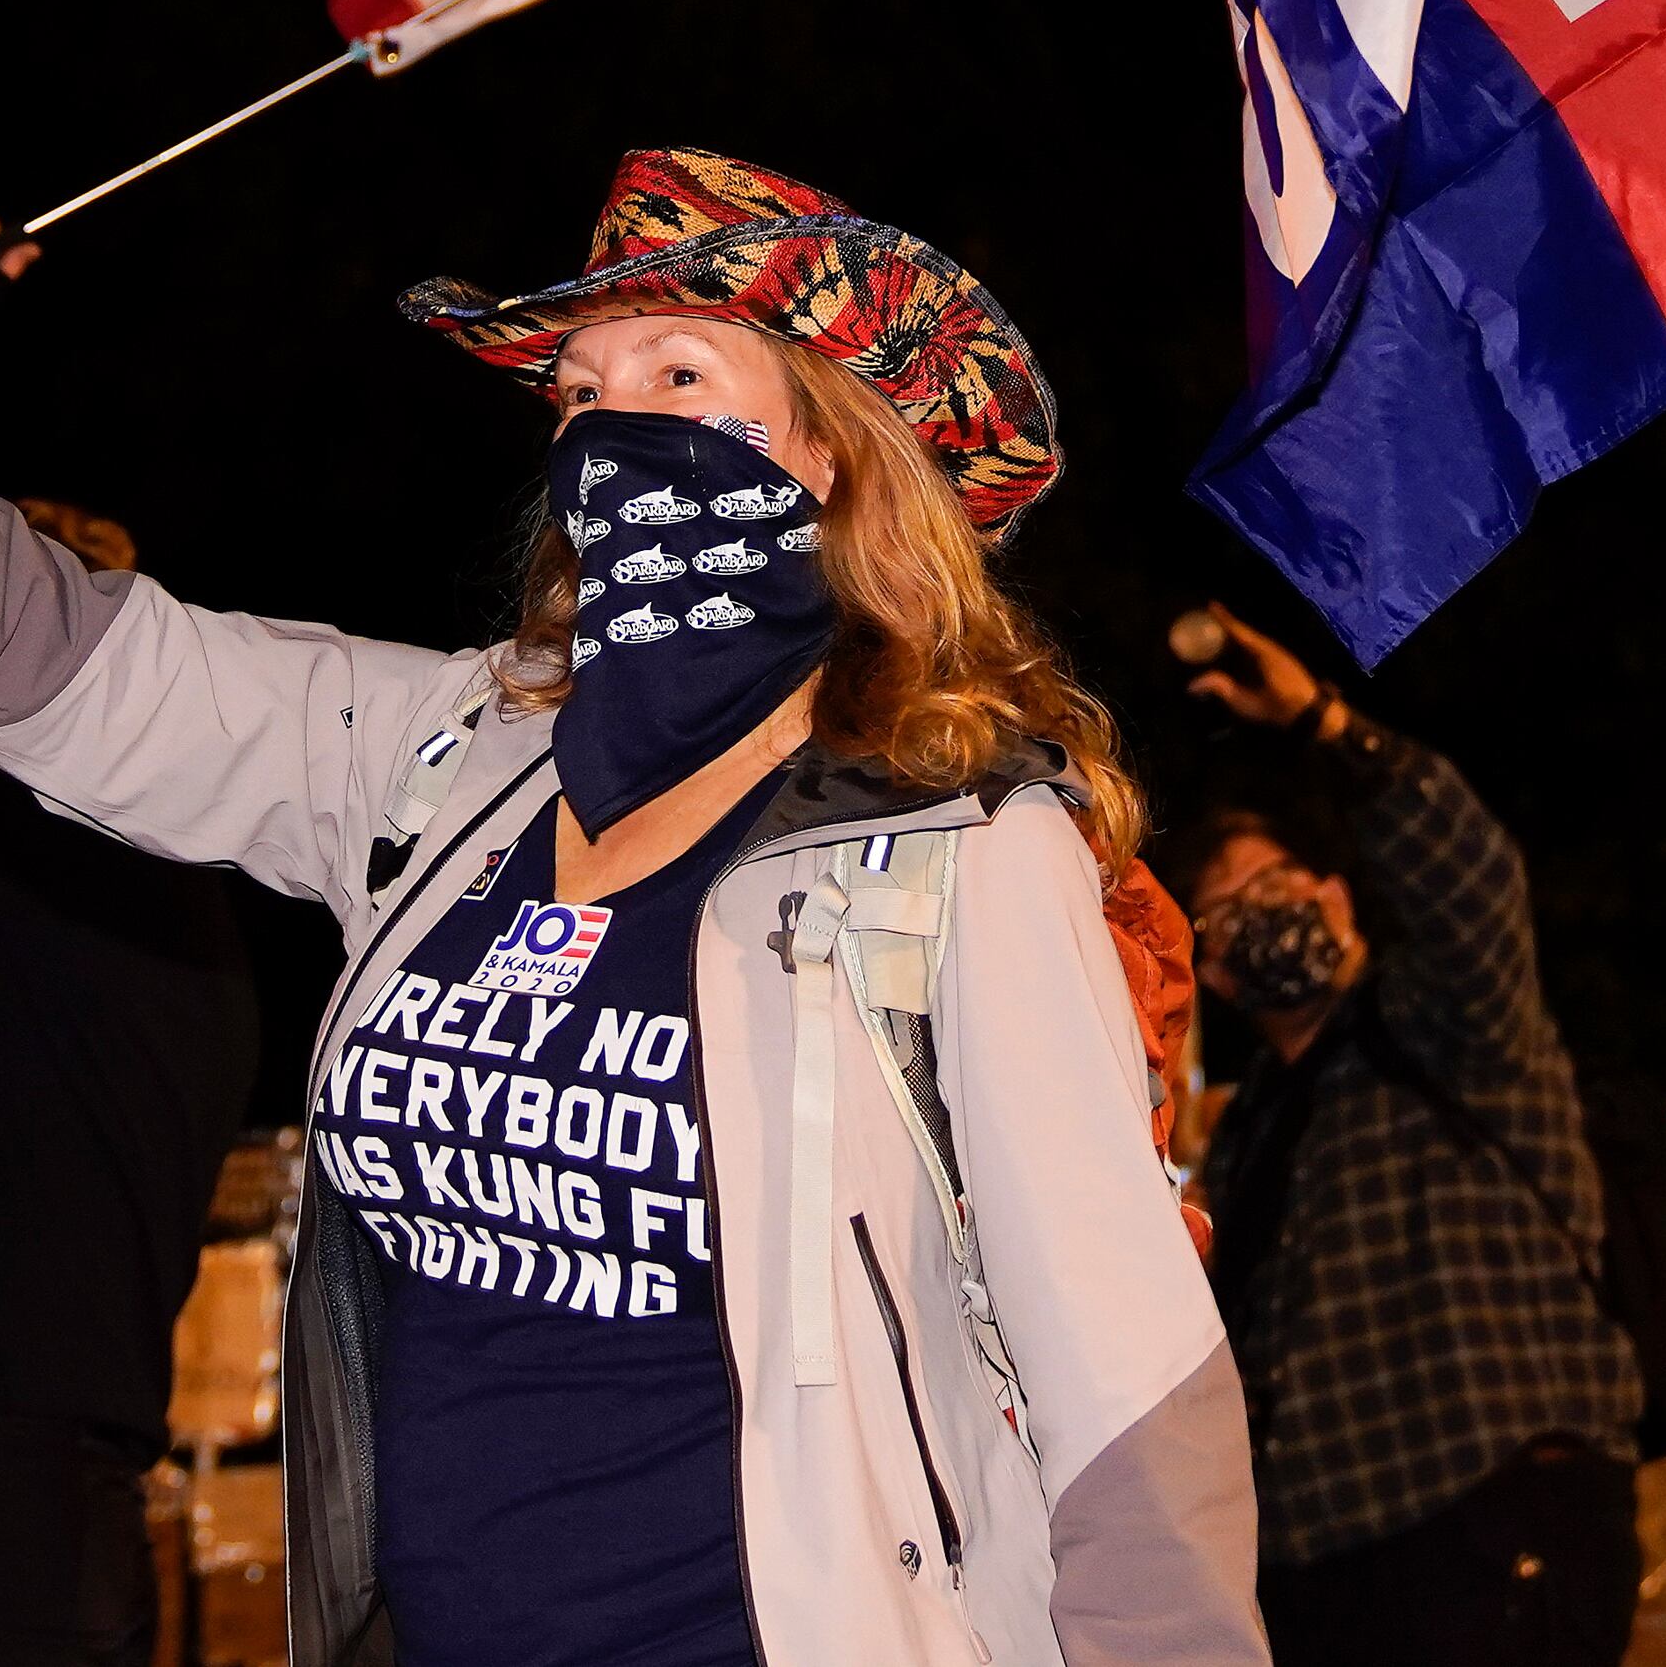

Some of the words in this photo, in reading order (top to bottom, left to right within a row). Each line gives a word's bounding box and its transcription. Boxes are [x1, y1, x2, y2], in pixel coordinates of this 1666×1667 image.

[624, 499, 699, 523] STARBOARD
[715, 494, 784, 517] STARBOARD
[616, 559, 683, 583] STARBOARD
[697, 549, 764, 573] STARBOARD
[691, 604, 752, 629] STARBOARD
[611, 618, 675, 642] STARBOARD
[495, 905, 609, 959] JOE
[485, 954, 500, 969] &
[500, 956, 581, 978] KAMALA
[475, 971, 573, 994] 2020
[316, 1045, 701, 1183] VERYBODY
[413, 1141, 606, 1241] KUNG
[358, 1209, 678, 1319] FIGHTING
